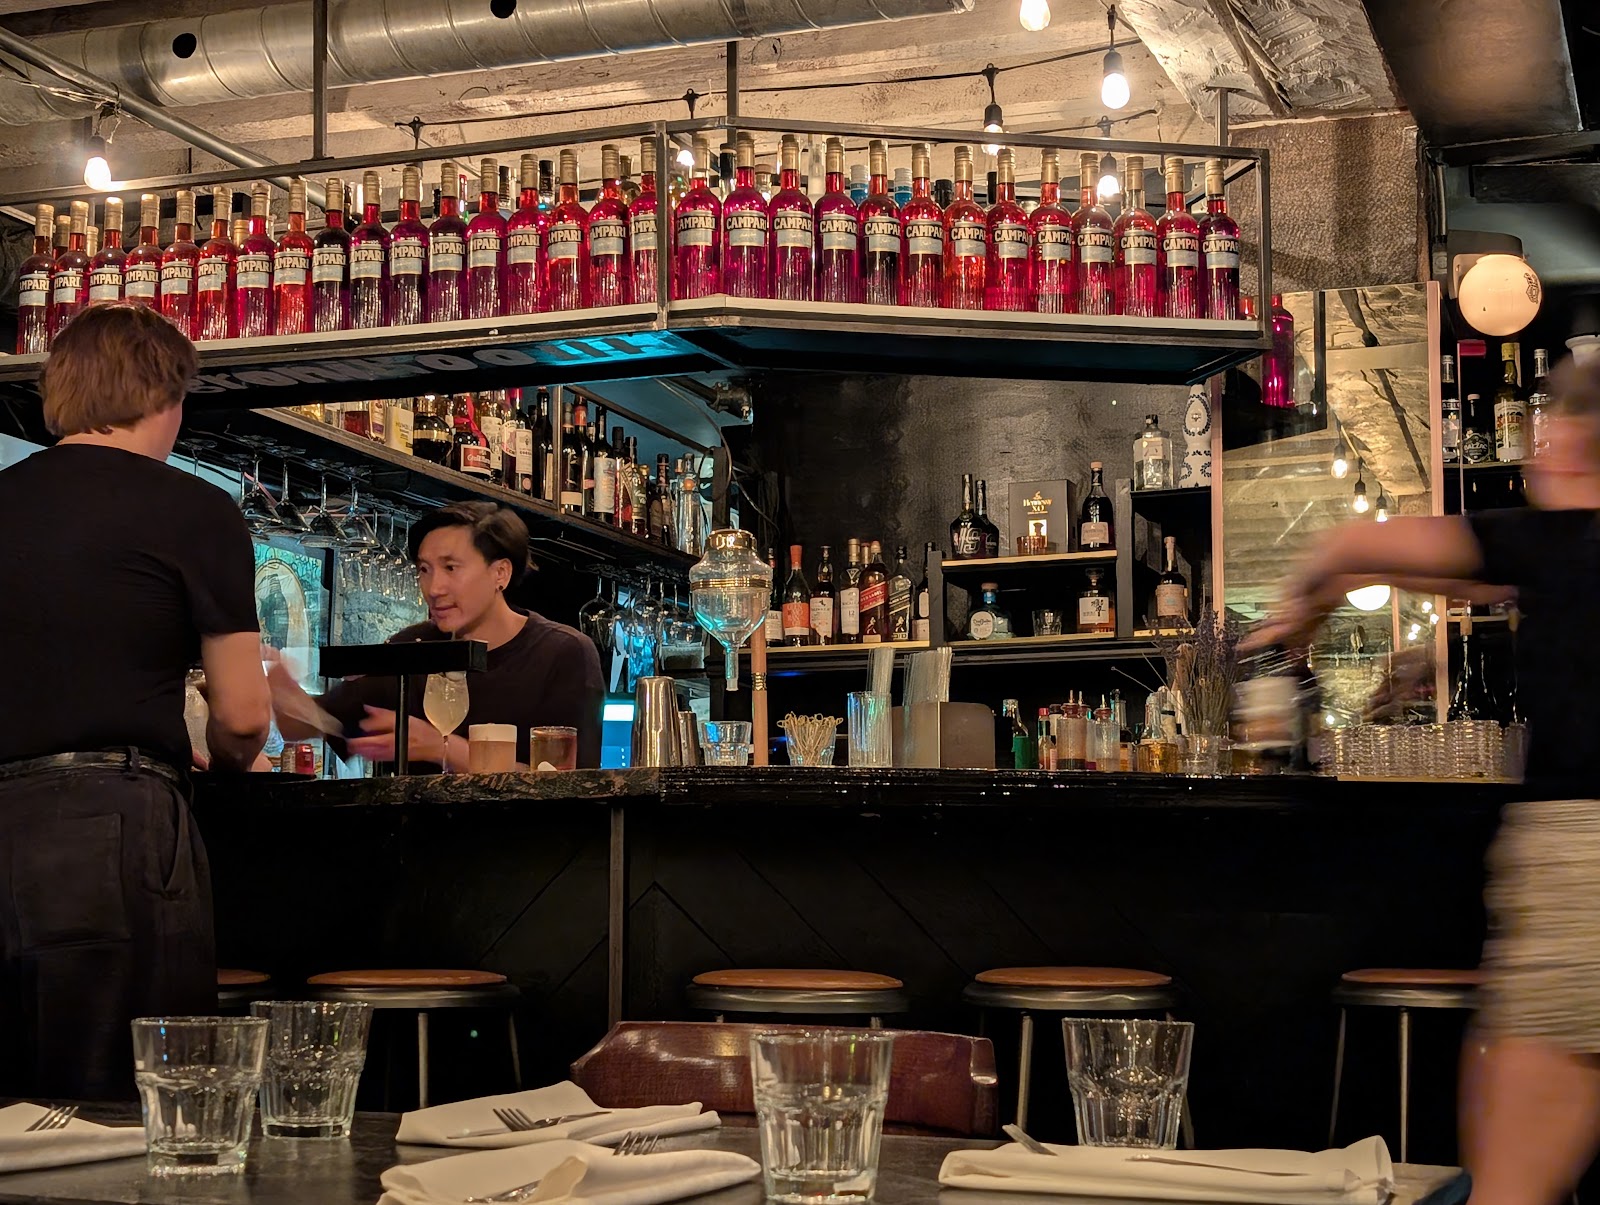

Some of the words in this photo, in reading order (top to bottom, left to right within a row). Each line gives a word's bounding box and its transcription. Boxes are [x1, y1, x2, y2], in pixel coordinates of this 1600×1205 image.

[630, 220, 657, 234] AMPA
[774, 216, 812, 231] CAMPAR
[592, 225, 626, 238] AMPARI
[391, 246, 425, 258] AMPARI
[431, 242, 465, 255] AMPARI
[313, 253, 346, 266] AMPARI
[351, 250, 384, 262] AMPARI
[237, 261, 272, 273] AMPARI
[275, 257, 309, 270] AMPARI
[90, 273, 122, 285] AMPARI
[126, 270, 158, 282] AMPARI
